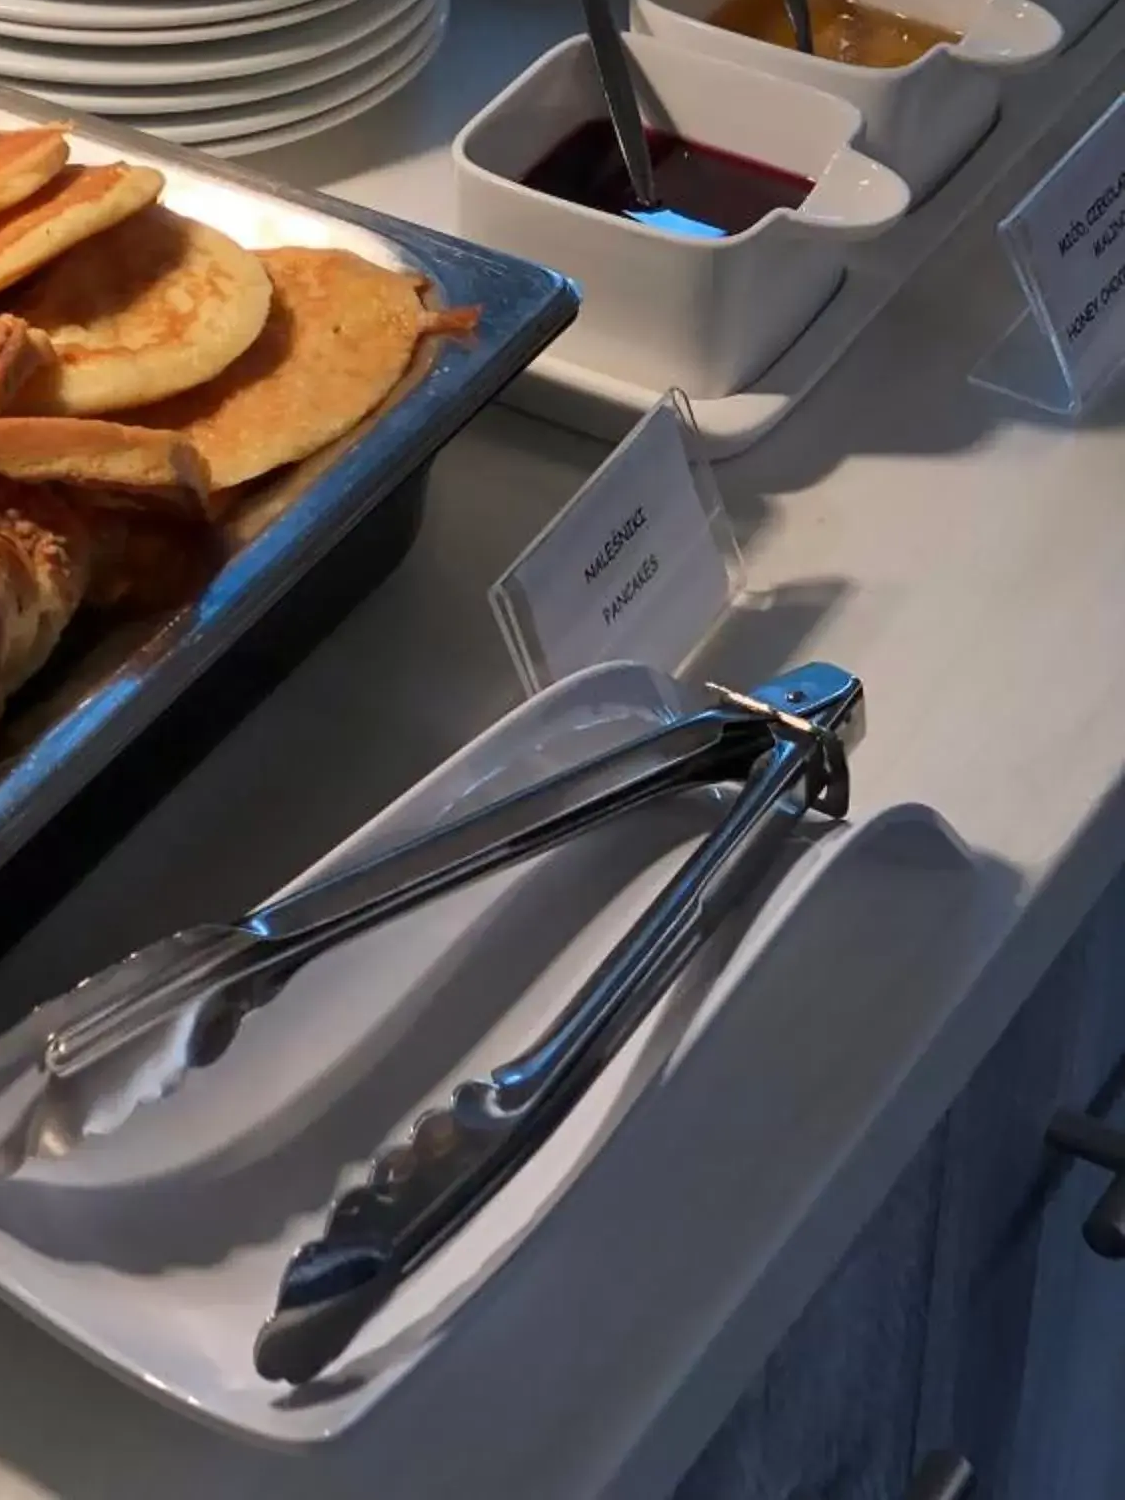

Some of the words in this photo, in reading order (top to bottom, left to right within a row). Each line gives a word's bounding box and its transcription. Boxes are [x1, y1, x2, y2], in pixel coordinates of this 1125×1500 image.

[1066, 297, 1098, 343] HONEY
[584, 506, 648, 584] NALEŚNIKI
[602, 553, 660, 627] PANCAKES
